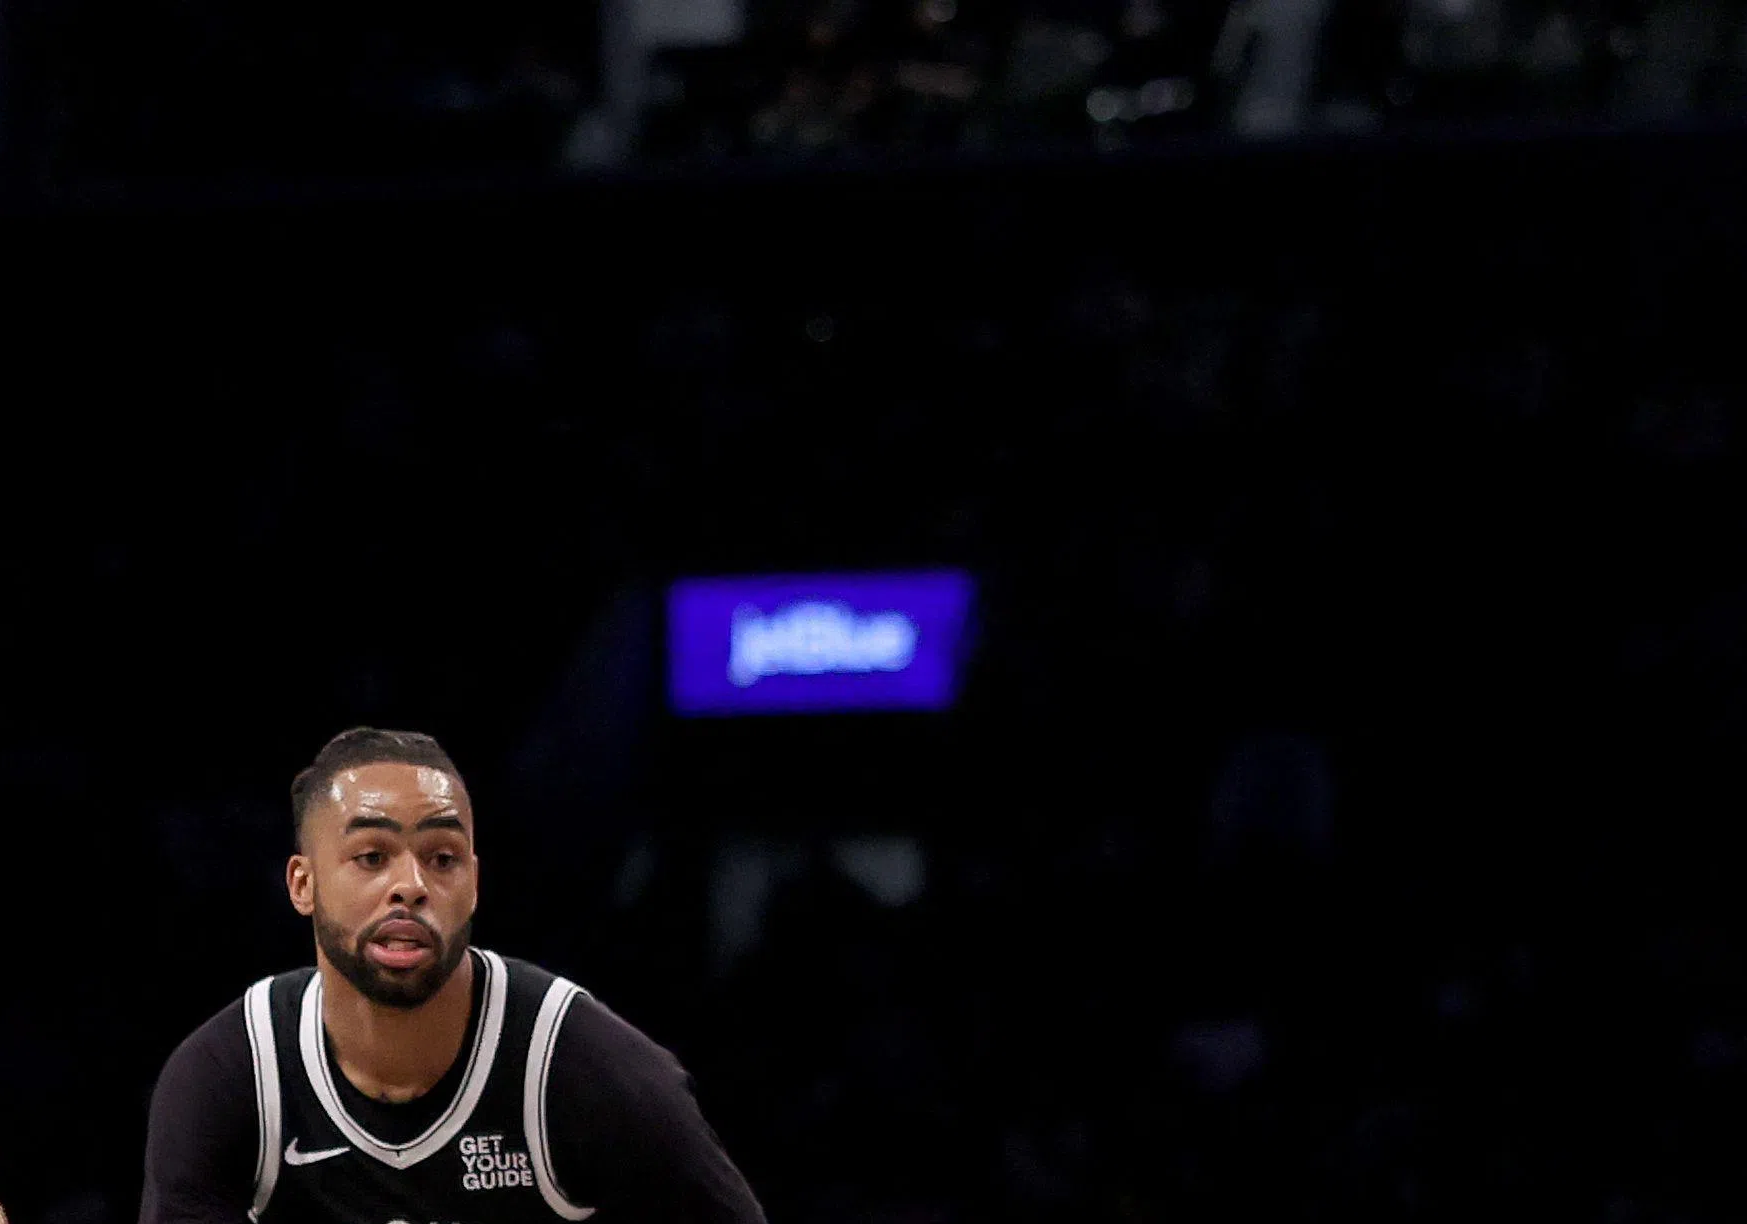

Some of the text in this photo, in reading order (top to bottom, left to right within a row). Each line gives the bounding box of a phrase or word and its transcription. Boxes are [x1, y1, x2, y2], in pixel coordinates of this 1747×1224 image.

[459, 1135, 503, 1155] GET
[461, 1152, 529, 1172] YOUR
[462, 1170, 534, 1190] GUIDE
